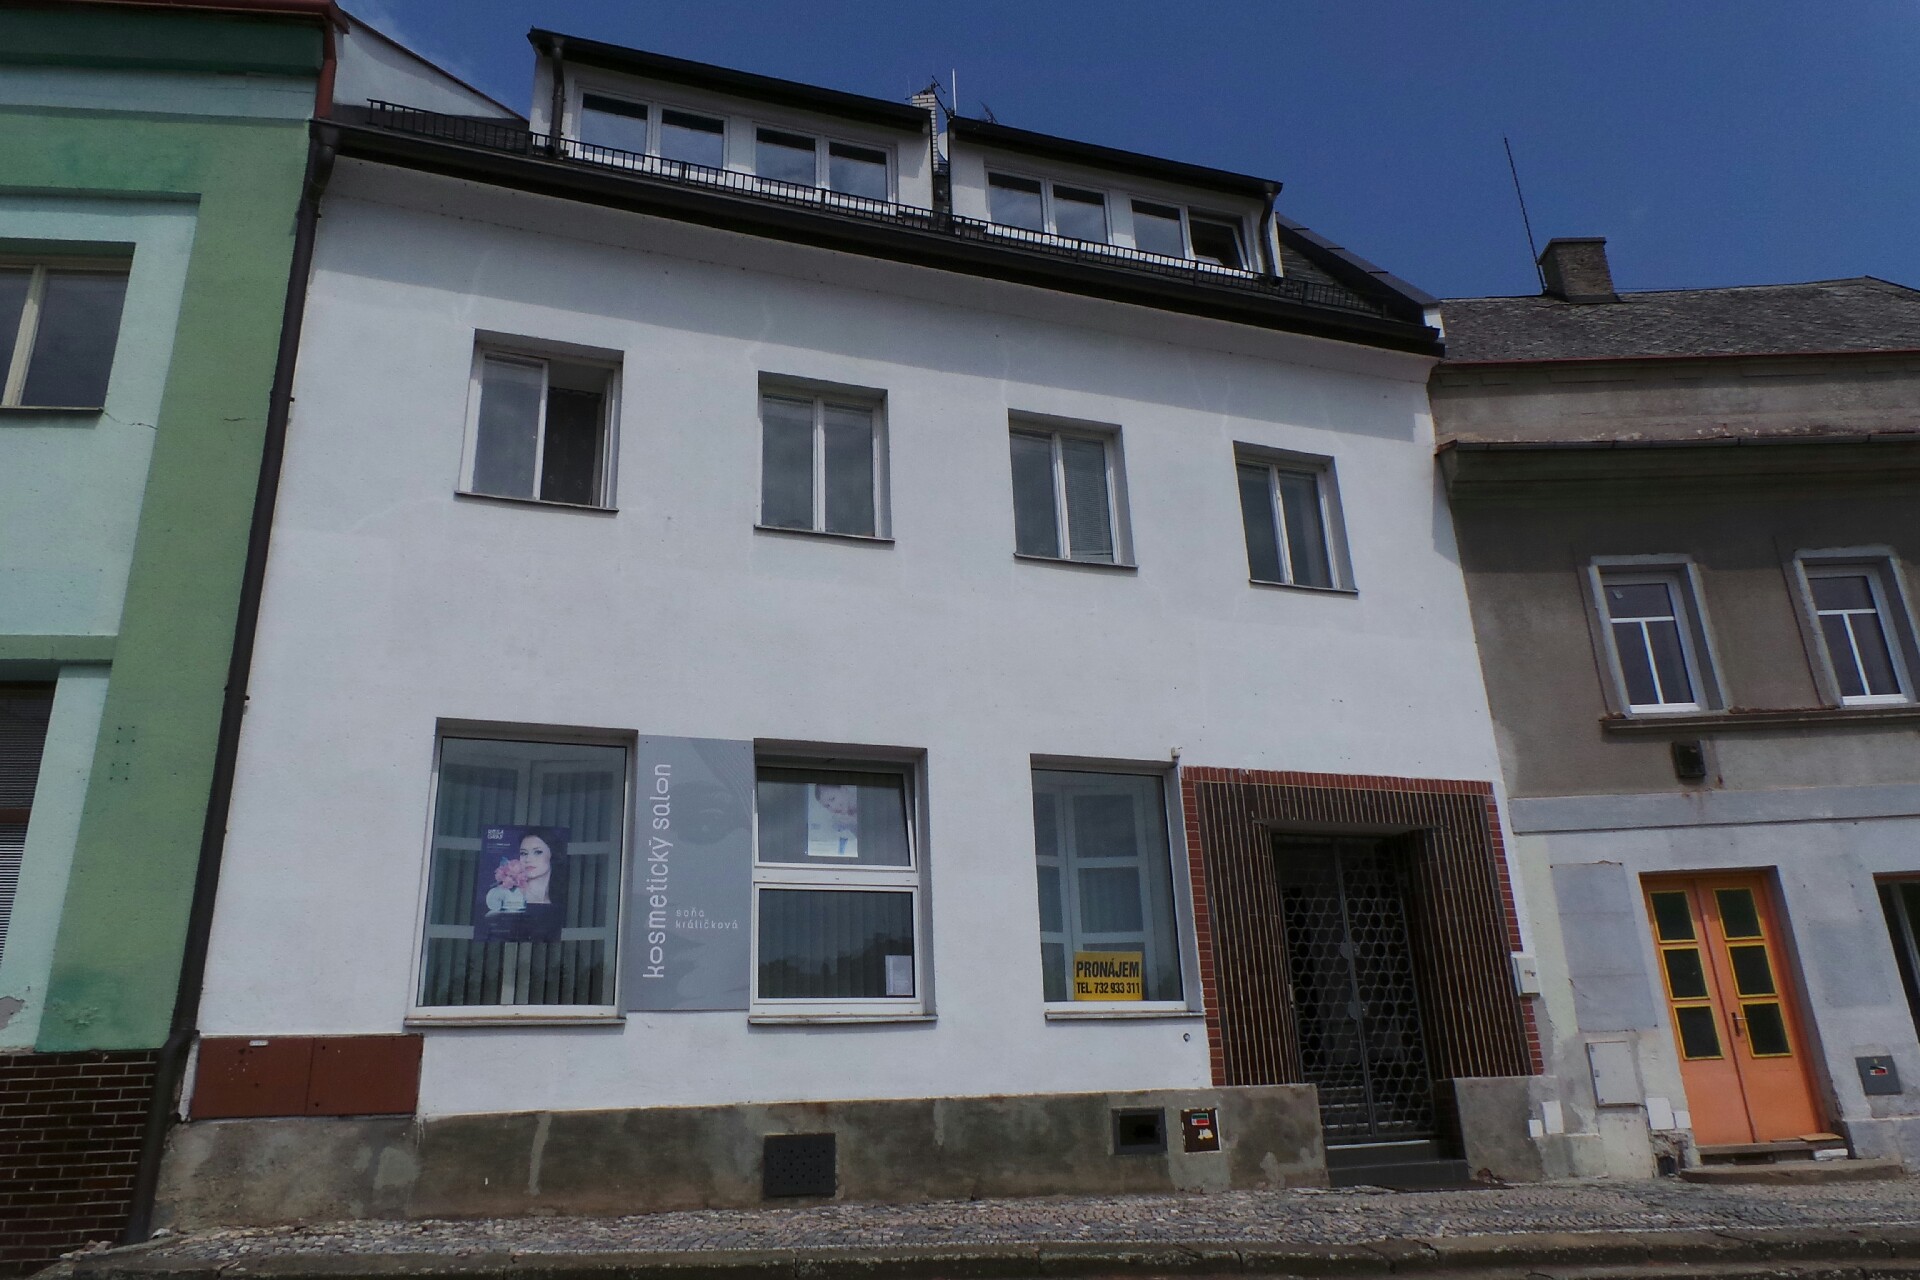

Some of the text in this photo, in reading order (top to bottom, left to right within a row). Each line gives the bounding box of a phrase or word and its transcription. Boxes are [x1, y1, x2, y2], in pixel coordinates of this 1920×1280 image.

[642, 764, 673, 978] kosmetický salon
[676, 907, 705, 917] soňa
[675, 919, 738, 929] králičková
[1076, 958, 1139, 978] PRONÁJEM
[1077, 982, 1140, 994] TEL. 732 933 311
